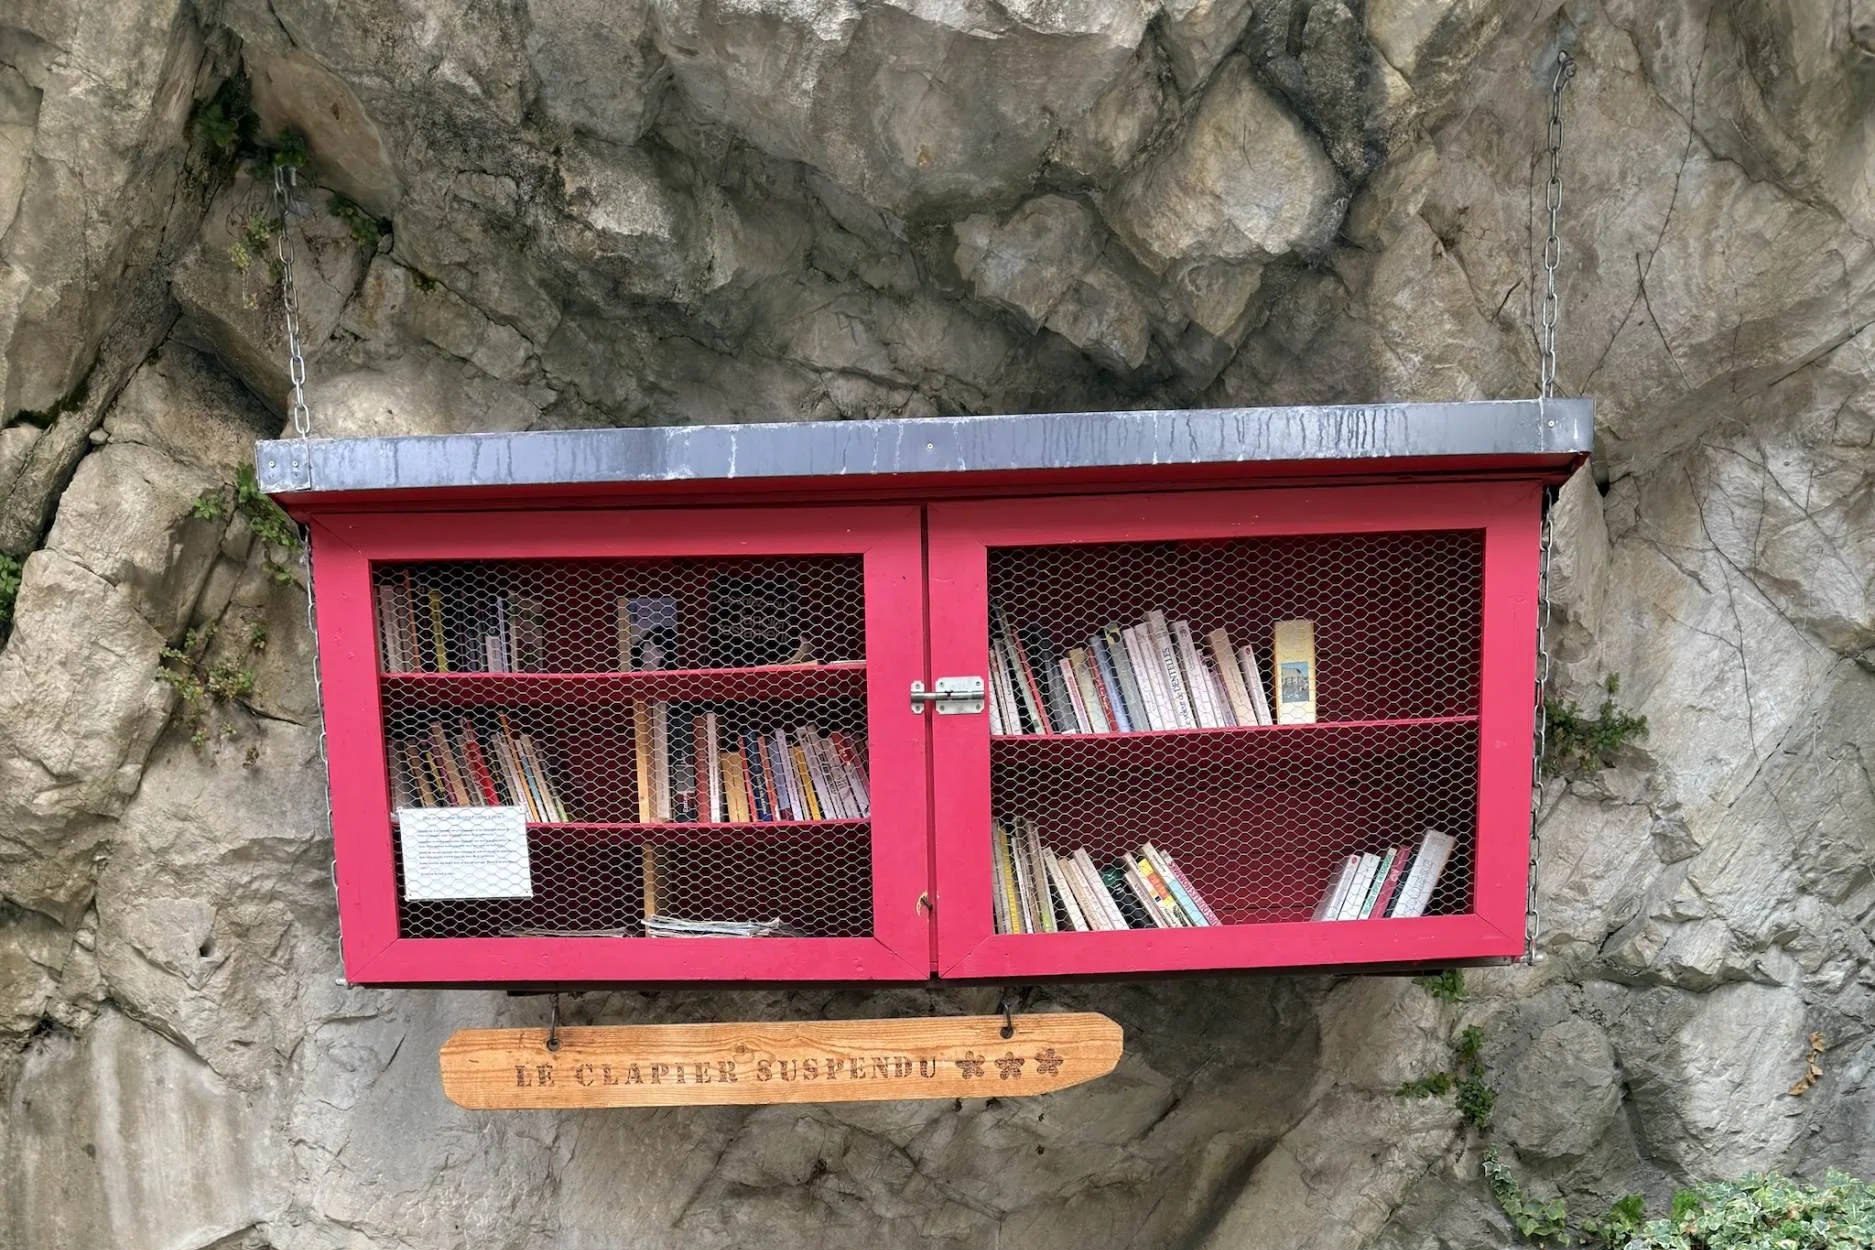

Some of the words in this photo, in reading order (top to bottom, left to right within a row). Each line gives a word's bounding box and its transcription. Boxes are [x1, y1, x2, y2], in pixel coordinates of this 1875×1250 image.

[515, 1062, 555, 1087] LE
[575, 1060, 738, 1086] CLAPIER
[756, 1055, 936, 1082] SUSPENDU
